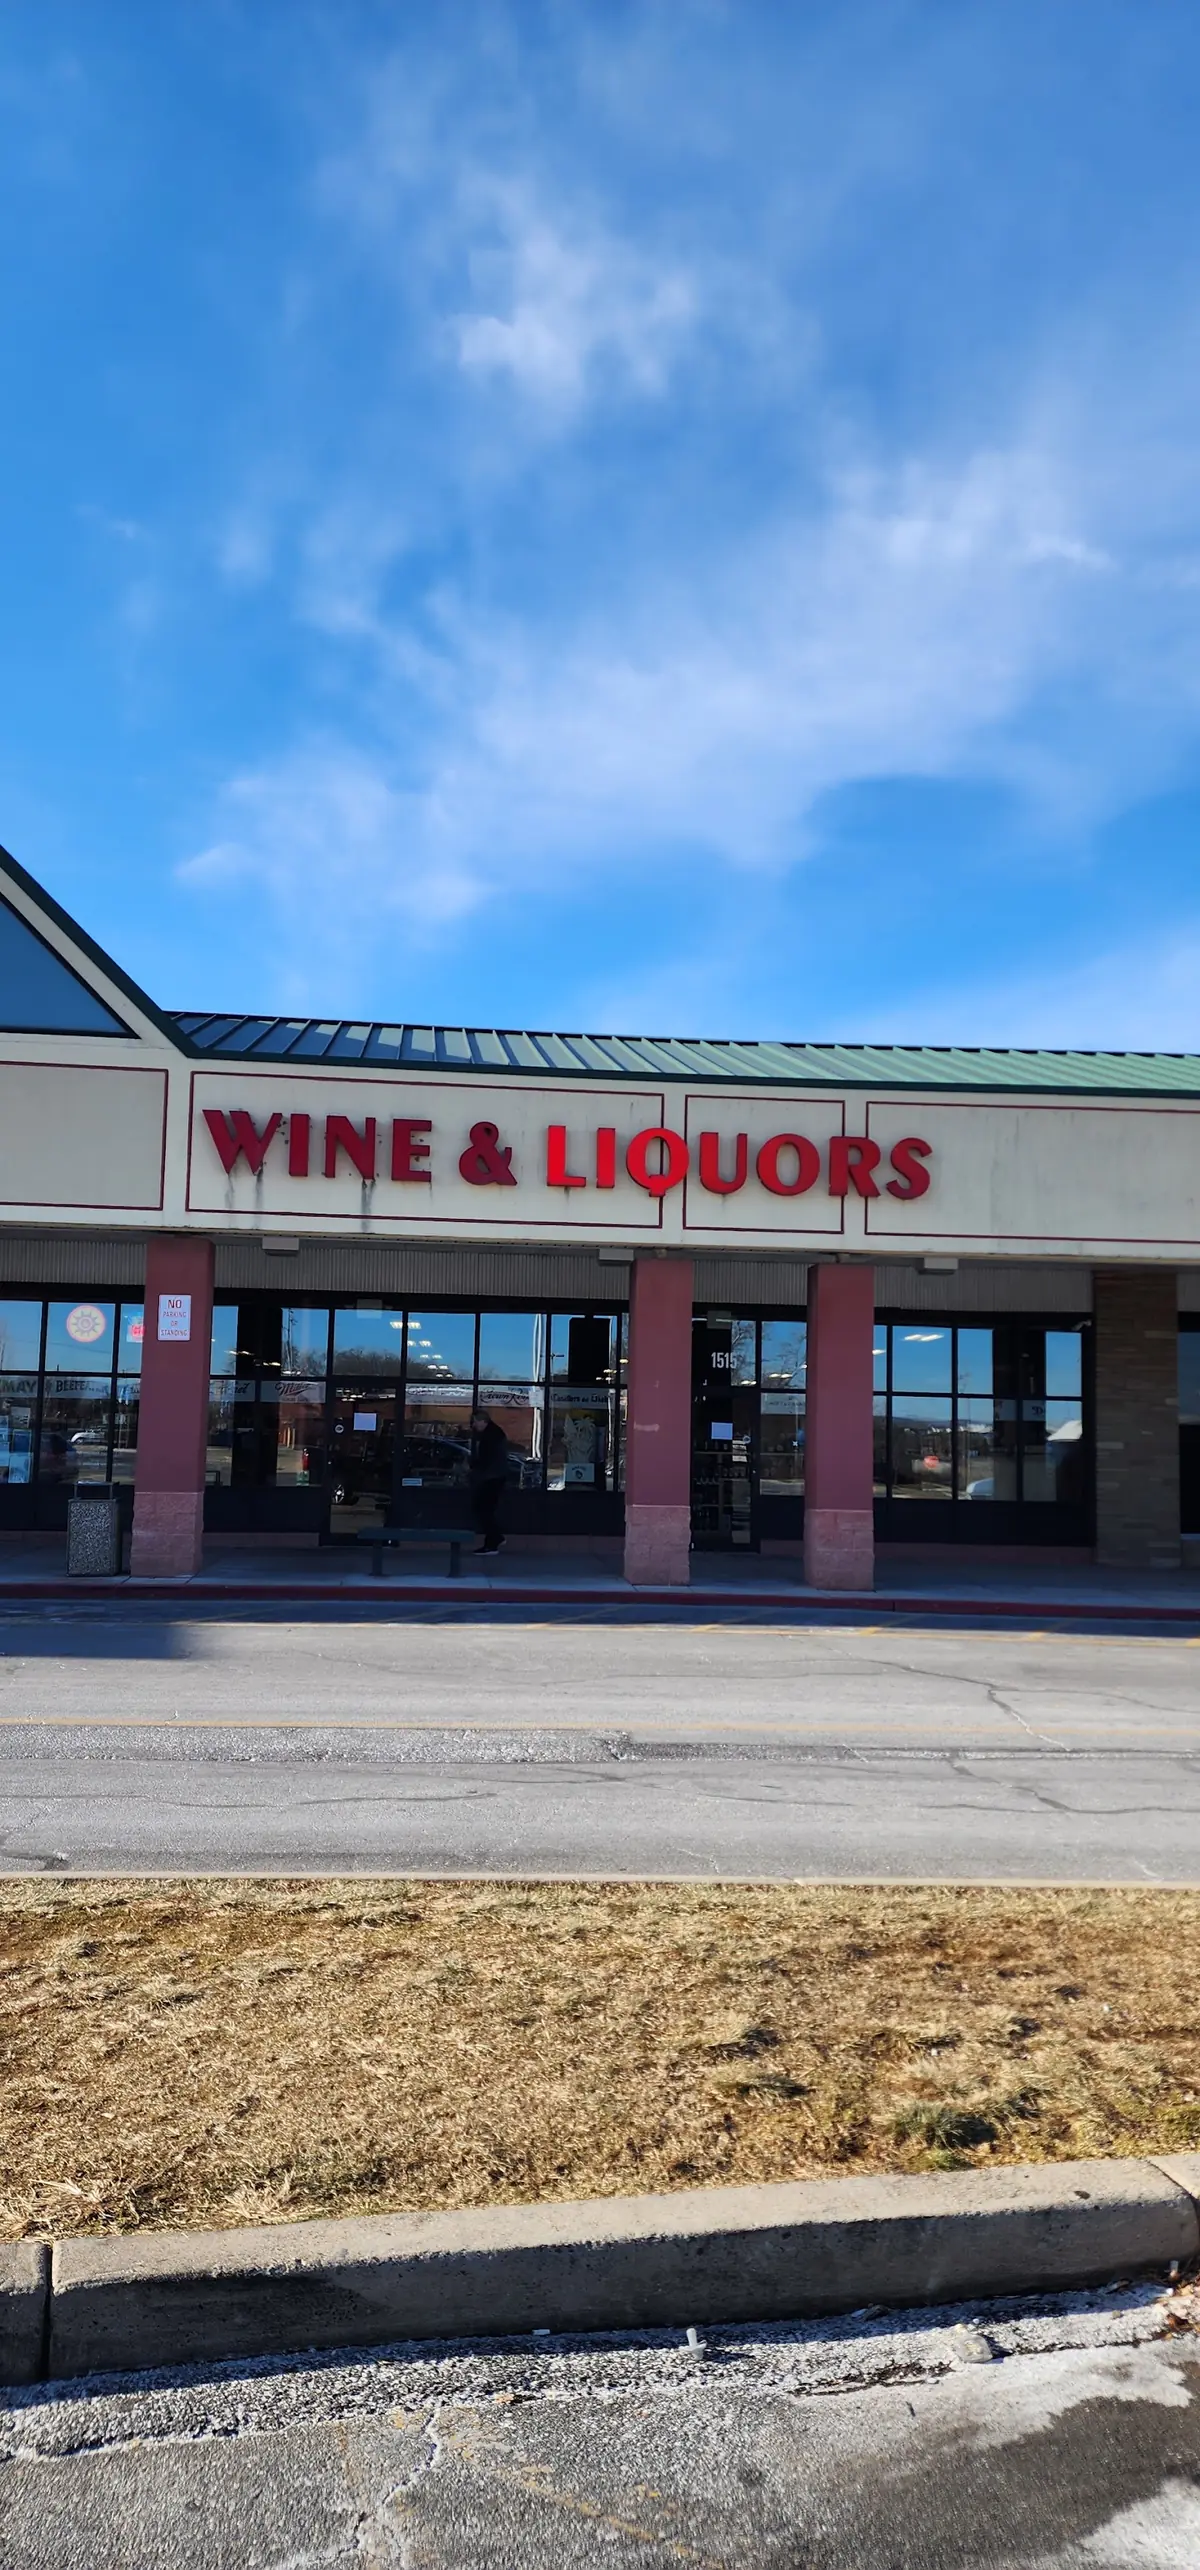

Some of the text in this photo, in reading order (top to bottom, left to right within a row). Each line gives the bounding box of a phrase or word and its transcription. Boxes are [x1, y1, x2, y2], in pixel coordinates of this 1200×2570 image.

[202, 1108, 934, 1200] WINE & LIQUORS
[167, 1299, 182, 1309] NO
[160, 1329, 188, 1337] STANDING
[711, 1351, 738, 1369] 1515
